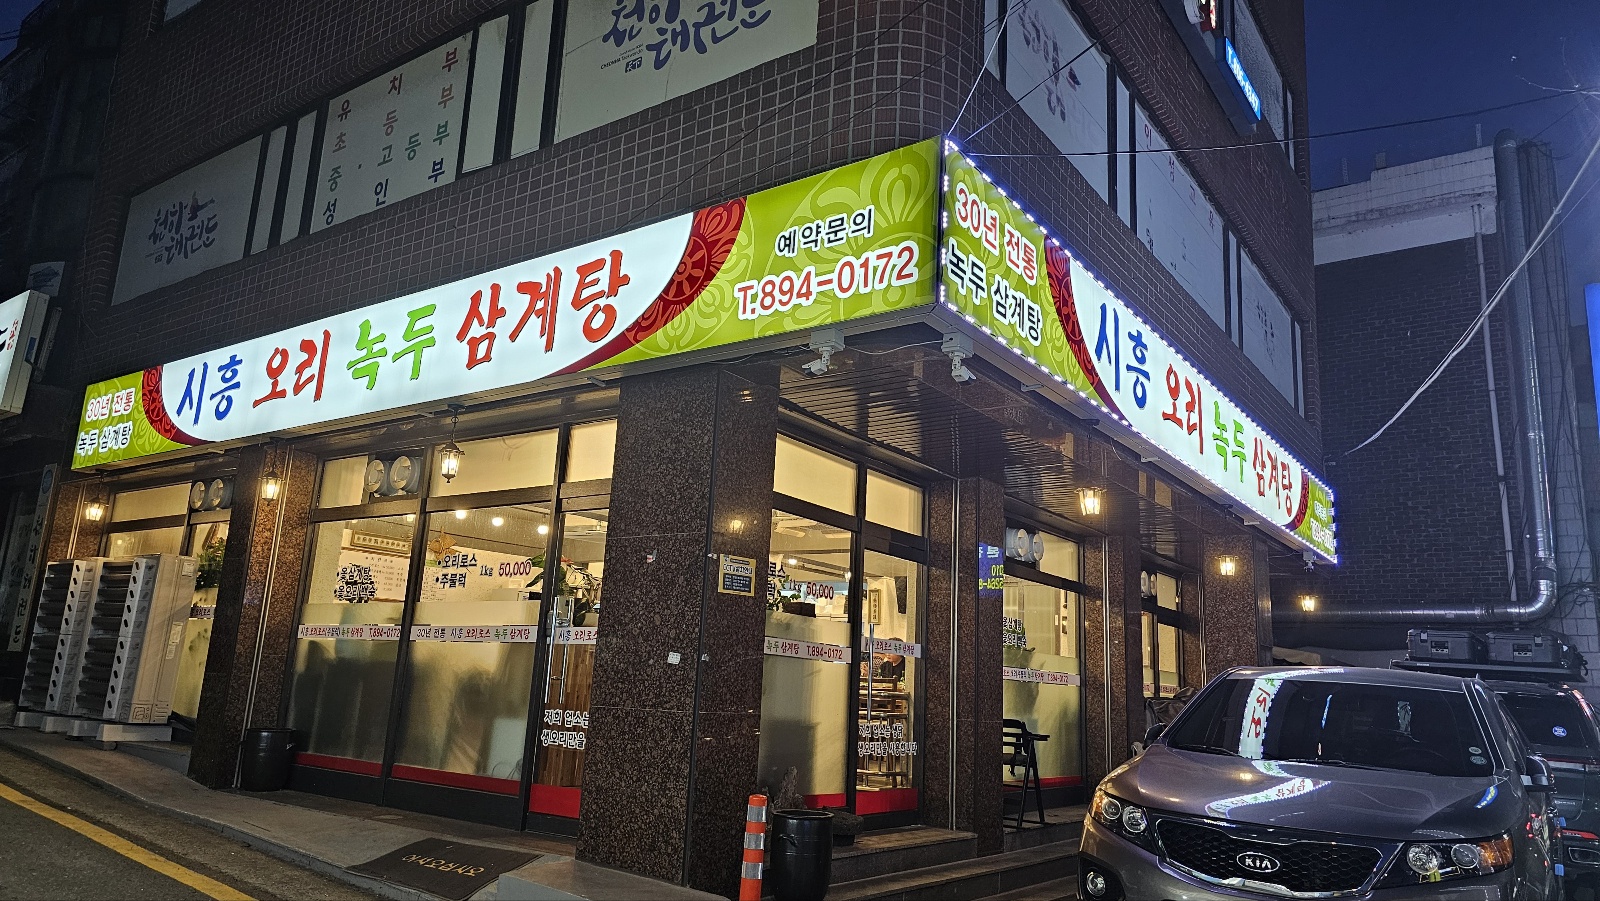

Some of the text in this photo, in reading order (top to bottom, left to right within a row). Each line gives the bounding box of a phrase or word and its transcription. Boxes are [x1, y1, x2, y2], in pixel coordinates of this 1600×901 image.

[777, 208, 872, 254] 예약문의
[957, 187, 1036, 281] 30년 전통
[738, 245, 915, 315] T.894-0172
[950, 243, 1042, 341] 녹두 삼계탕
[176, 249, 631, 427] 시흥 오리 녹두 삼계탕
[87, 390, 134, 419] 30년 전통
[1094, 302, 1293, 518] 시흥 오리 녹두 삼계탕
[77, 424, 132, 454] 녹두 삼계탕
[442, 553, 478, 569] 오리로스
[498, 561, 532, 578] 50,000
[440, 573, 467, 589] 주물럭
[806, 582, 834, 600] 50,000
[369, 627, 401, 639] T.894-0172
[416, 628, 432, 639] 30년
[433, 628, 446, 639] 전통
[450, 628, 463, 639] 시흥
[464, 628, 491, 639] 오리로스
[509, 628, 531, 640] 삼계탕
[806, 645, 843, 660] T.894-0172
[1244, 855, 1272, 870] KIA
